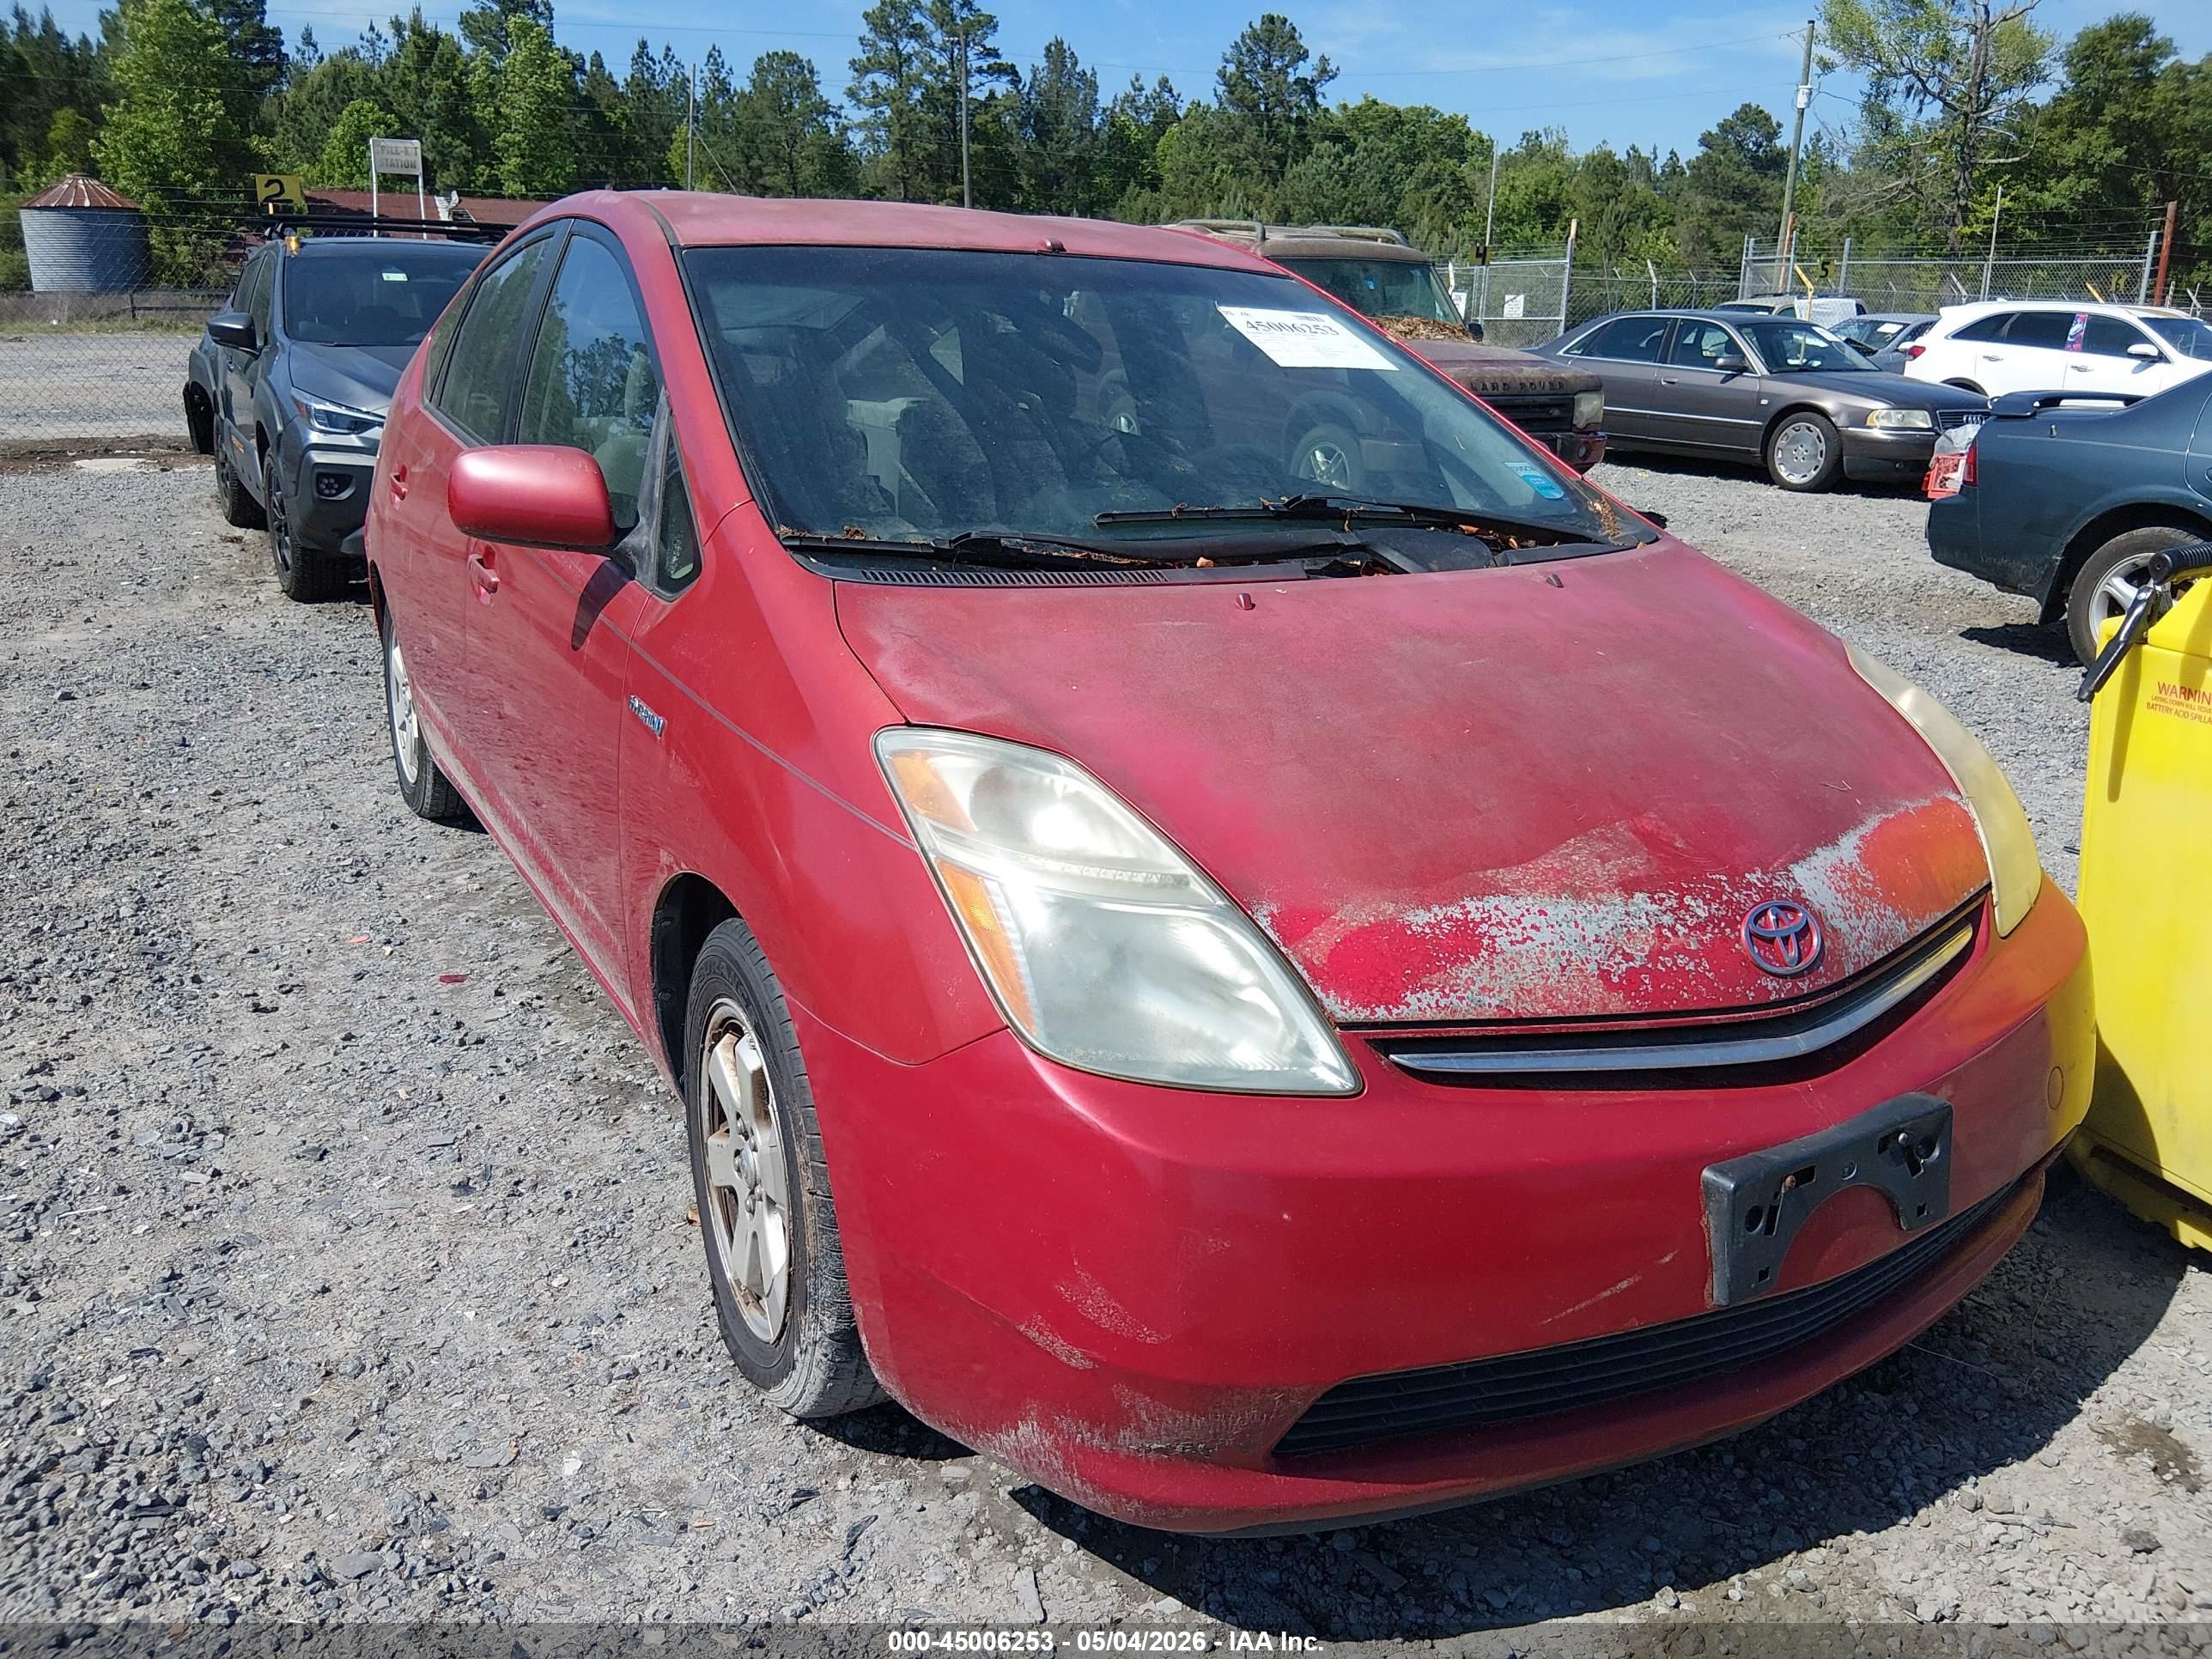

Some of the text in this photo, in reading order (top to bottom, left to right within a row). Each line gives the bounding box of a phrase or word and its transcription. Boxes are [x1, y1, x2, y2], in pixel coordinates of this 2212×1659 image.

[261, 179, 293, 202] 2
[1820, 261, 1830, 278] 5
[1246, 319, 1340, 336] 45006253
[1470, 381, 1565, 392] LAND ROVER
[2157, 681, 2212, 705] WARNIN
[2146, 702, 2212, 726] BATTERY ACID SPILLA
